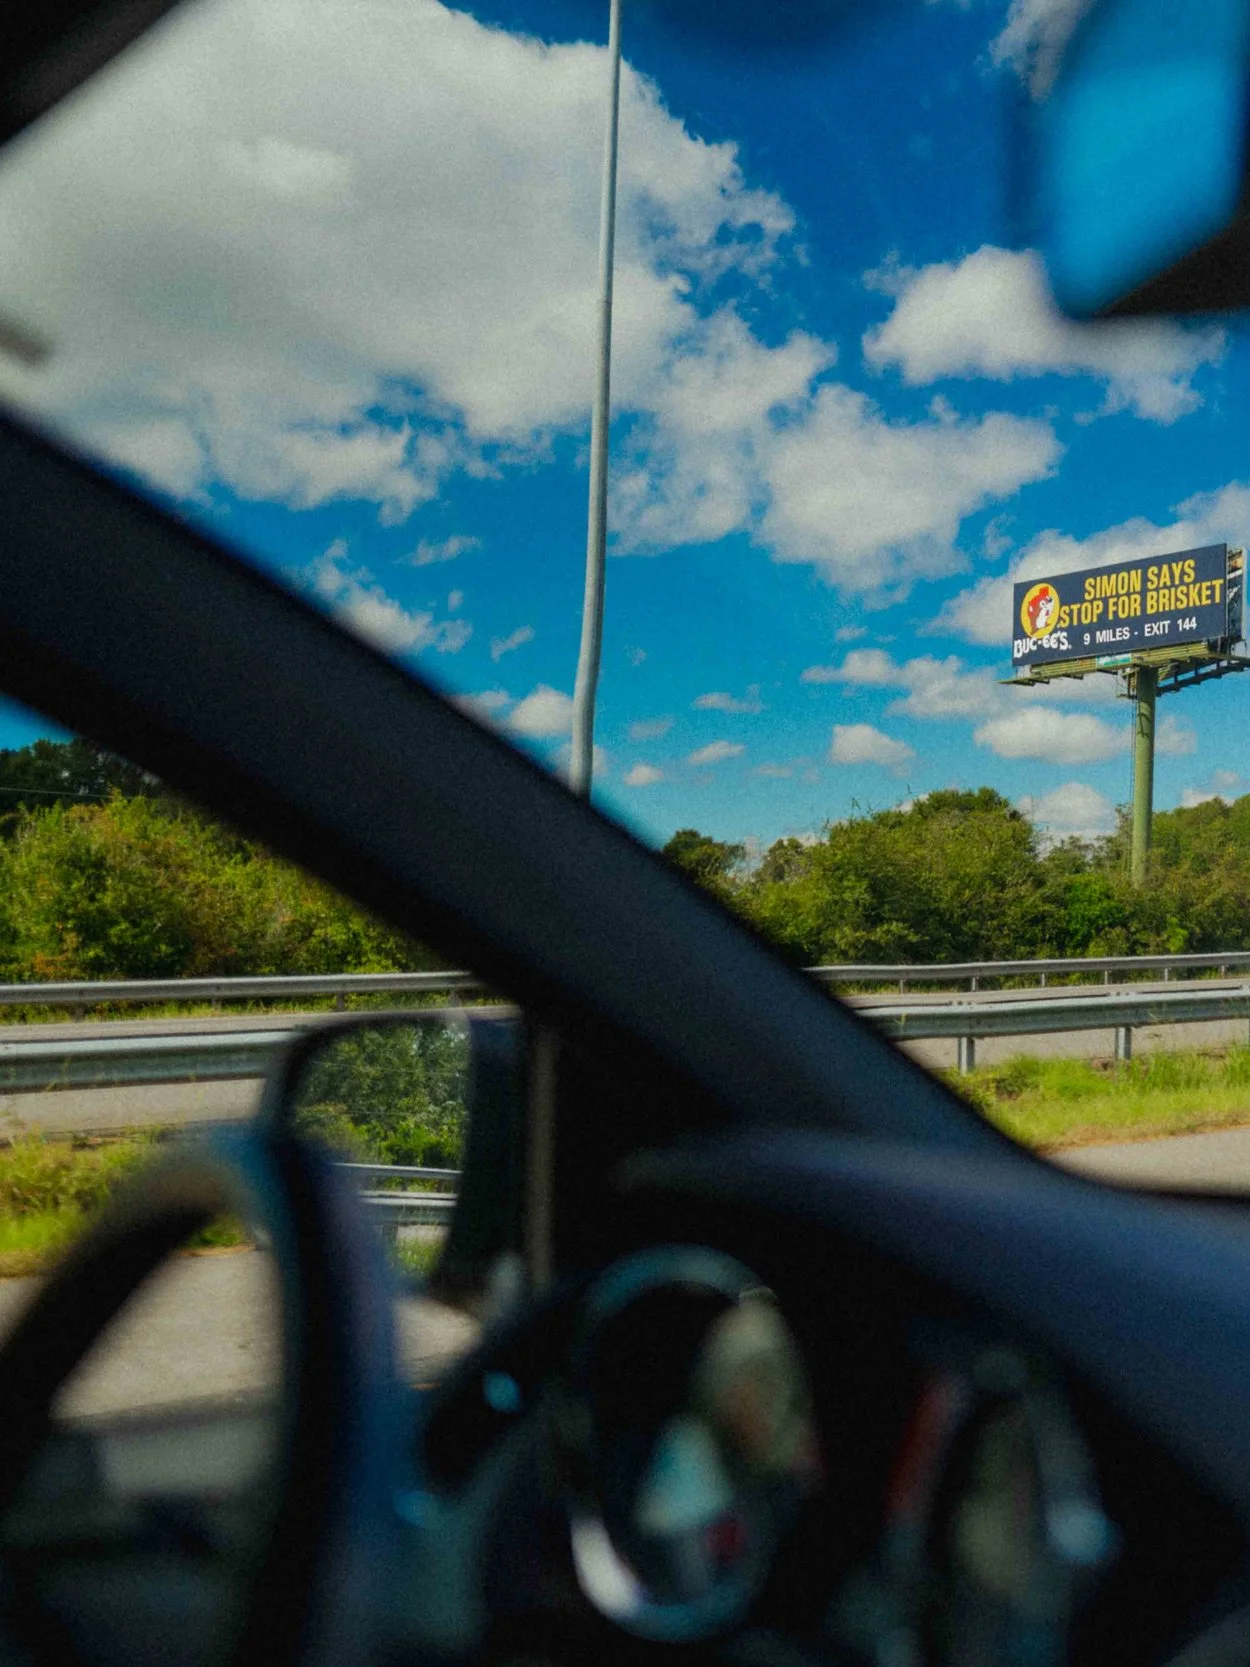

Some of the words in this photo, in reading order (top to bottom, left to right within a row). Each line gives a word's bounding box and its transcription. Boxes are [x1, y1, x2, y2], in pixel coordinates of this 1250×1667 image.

[1084, 568, 1142, 601] SIMON
[1147, 559, 1195, 590] SAYS
[1059, 602, 1103, 628] STOP
[1108, 594, 1141, 620] FOR
[1146, 578, 1224, 615] BRISKET
[1083, 633, 1091, 646] 9
[1095, 626, 1130, 644] MILES
[1144, 619, 1171, 637] EXIT
[1176, 616, 1198, 632] 144
